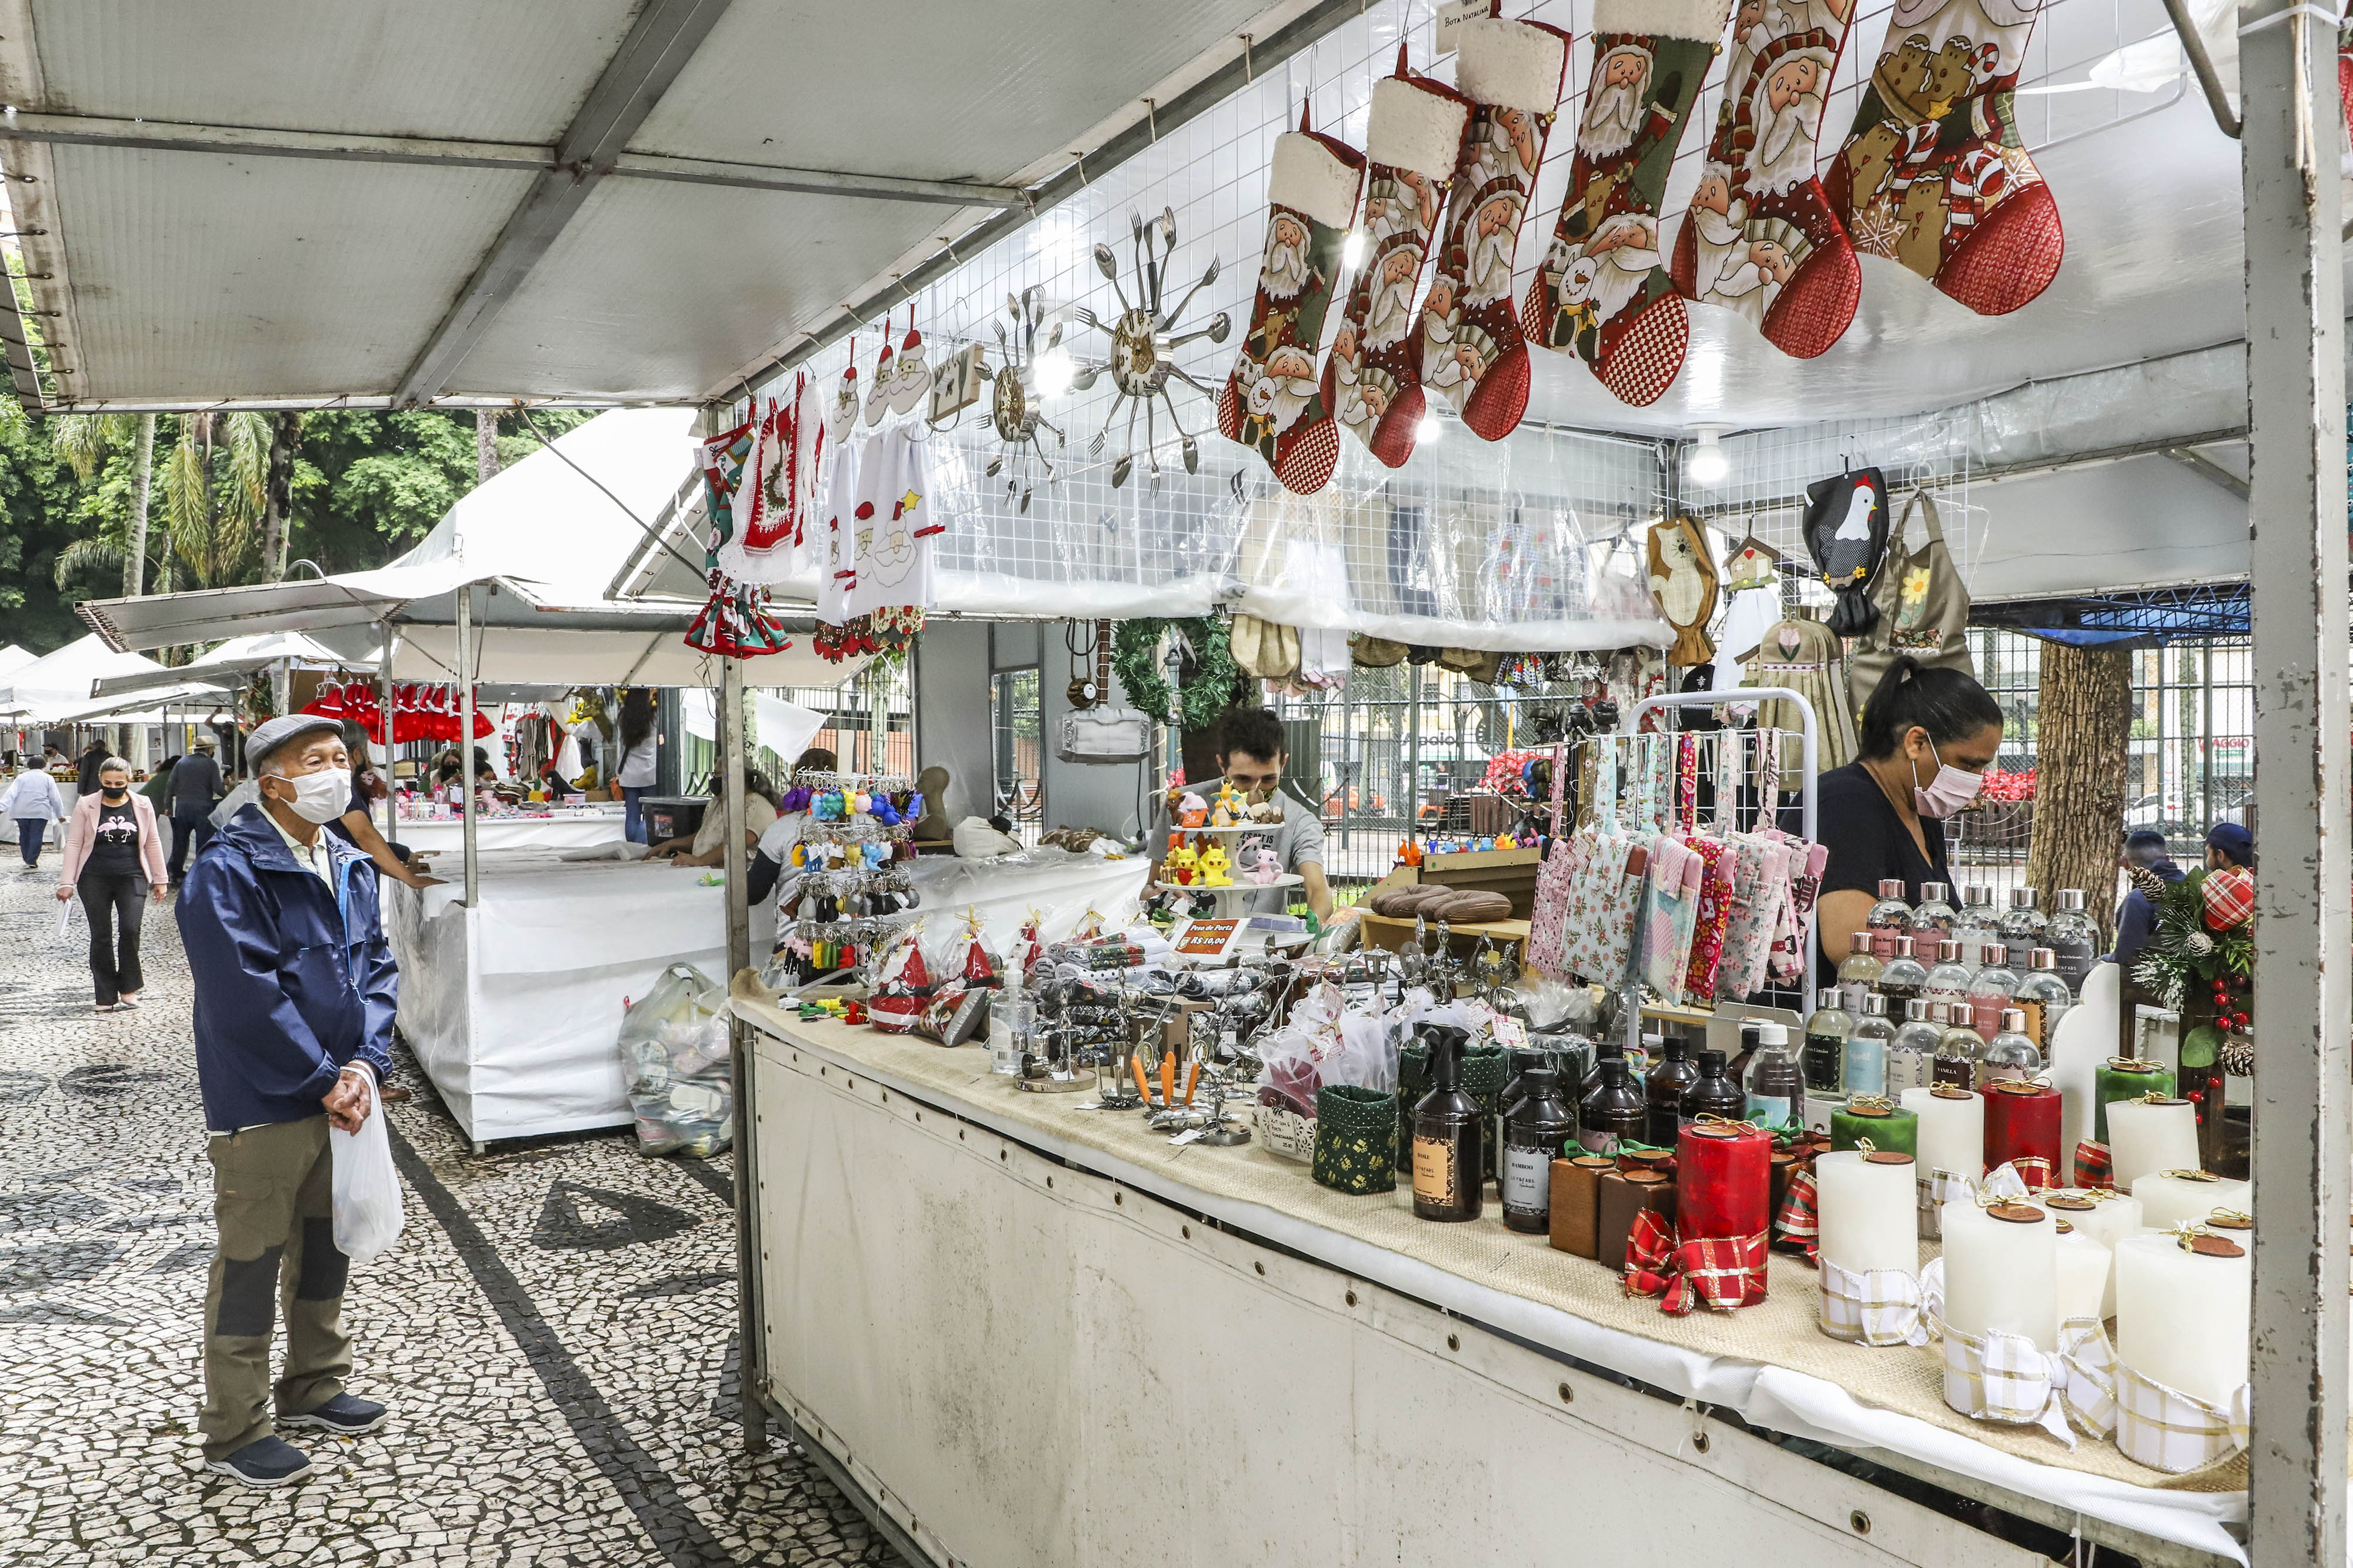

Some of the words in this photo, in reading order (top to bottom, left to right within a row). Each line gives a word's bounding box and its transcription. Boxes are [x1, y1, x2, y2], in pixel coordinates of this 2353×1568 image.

[1445, 16, 1461, 28] BOTA
[1463, 5, 1489, 21] NATALINA
[2198, 735, 2250, 752] VAGGIO
[1266, 835, 1274, 843] IS
[1190, 936, 1202, 945] R$
[1202, 937, 1225, 945] 10,00
[1512, 1162, 1534, 1170] BAMBOO
